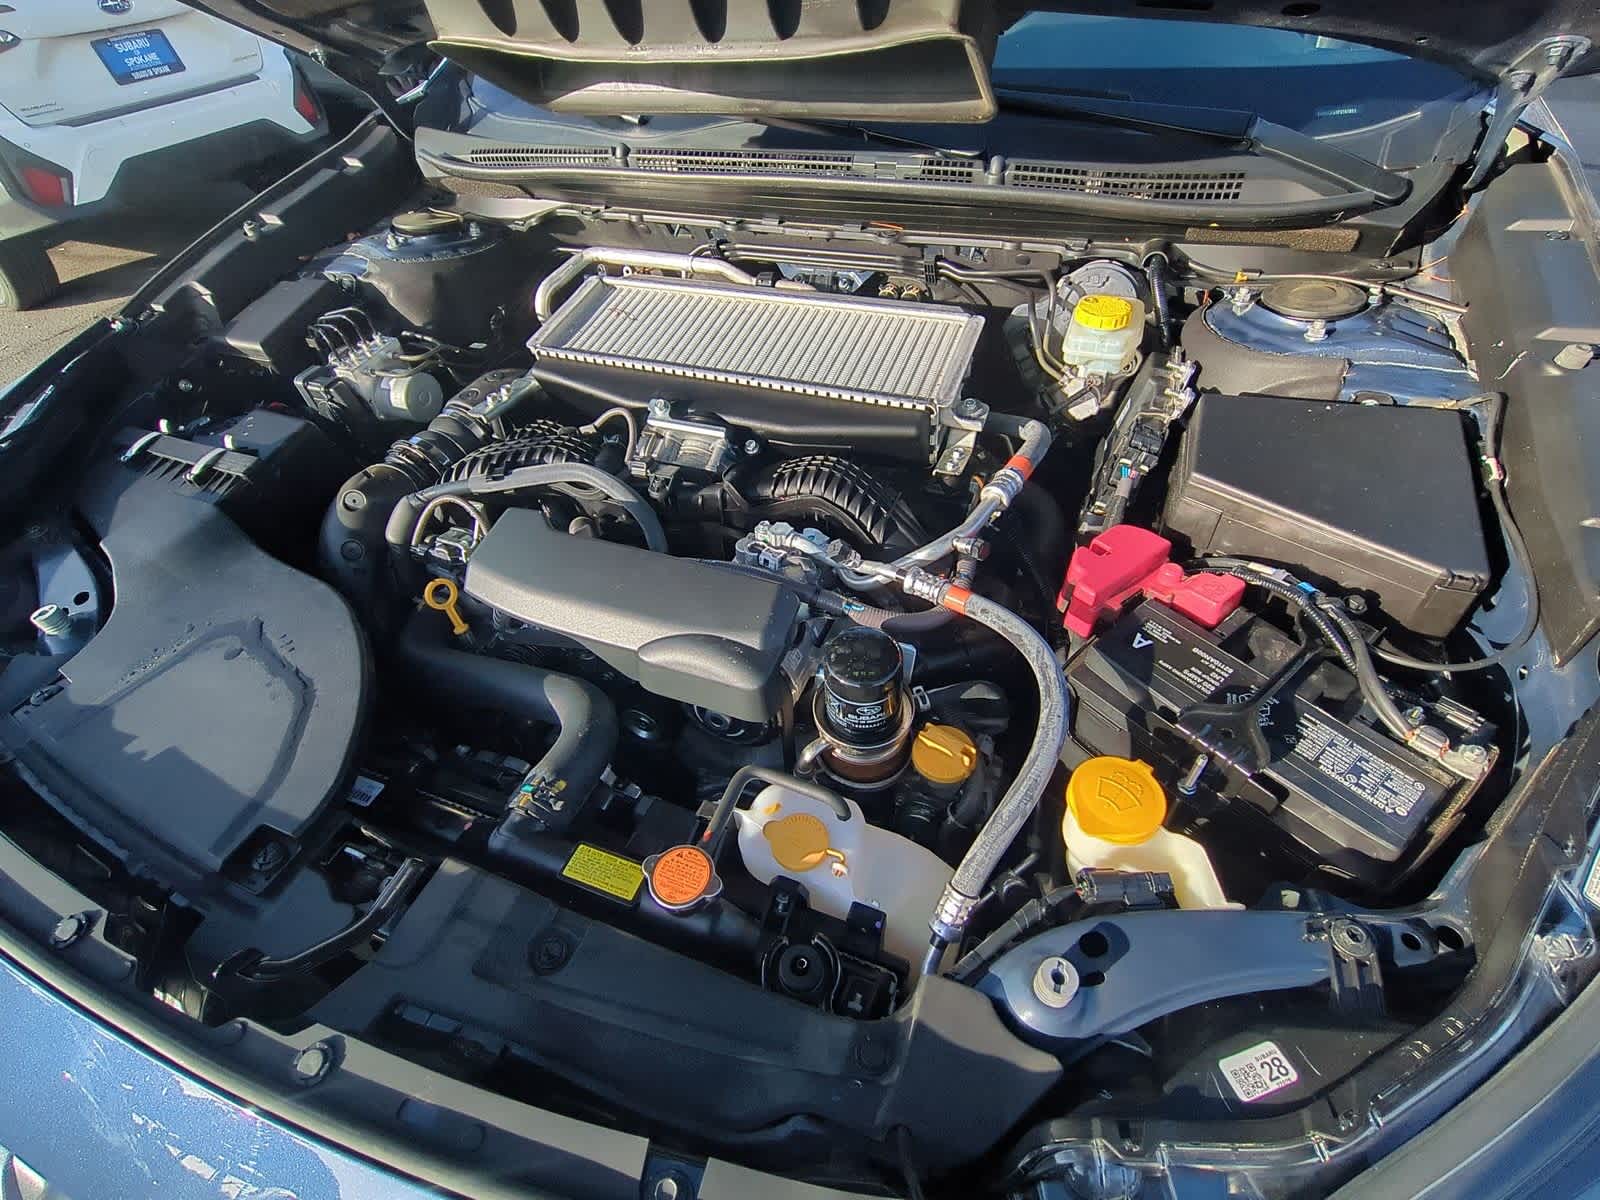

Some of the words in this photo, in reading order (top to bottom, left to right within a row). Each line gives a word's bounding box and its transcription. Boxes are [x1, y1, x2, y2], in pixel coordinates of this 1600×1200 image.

[114, 37, 150, 53] SUBARU
[123, 52, 160, 67] SPOKANE
[1132, 632, 1154, 649] A
[1182, 669, 1204, 683] AMPS
[1260, 1056, 1289, 1082] 28
